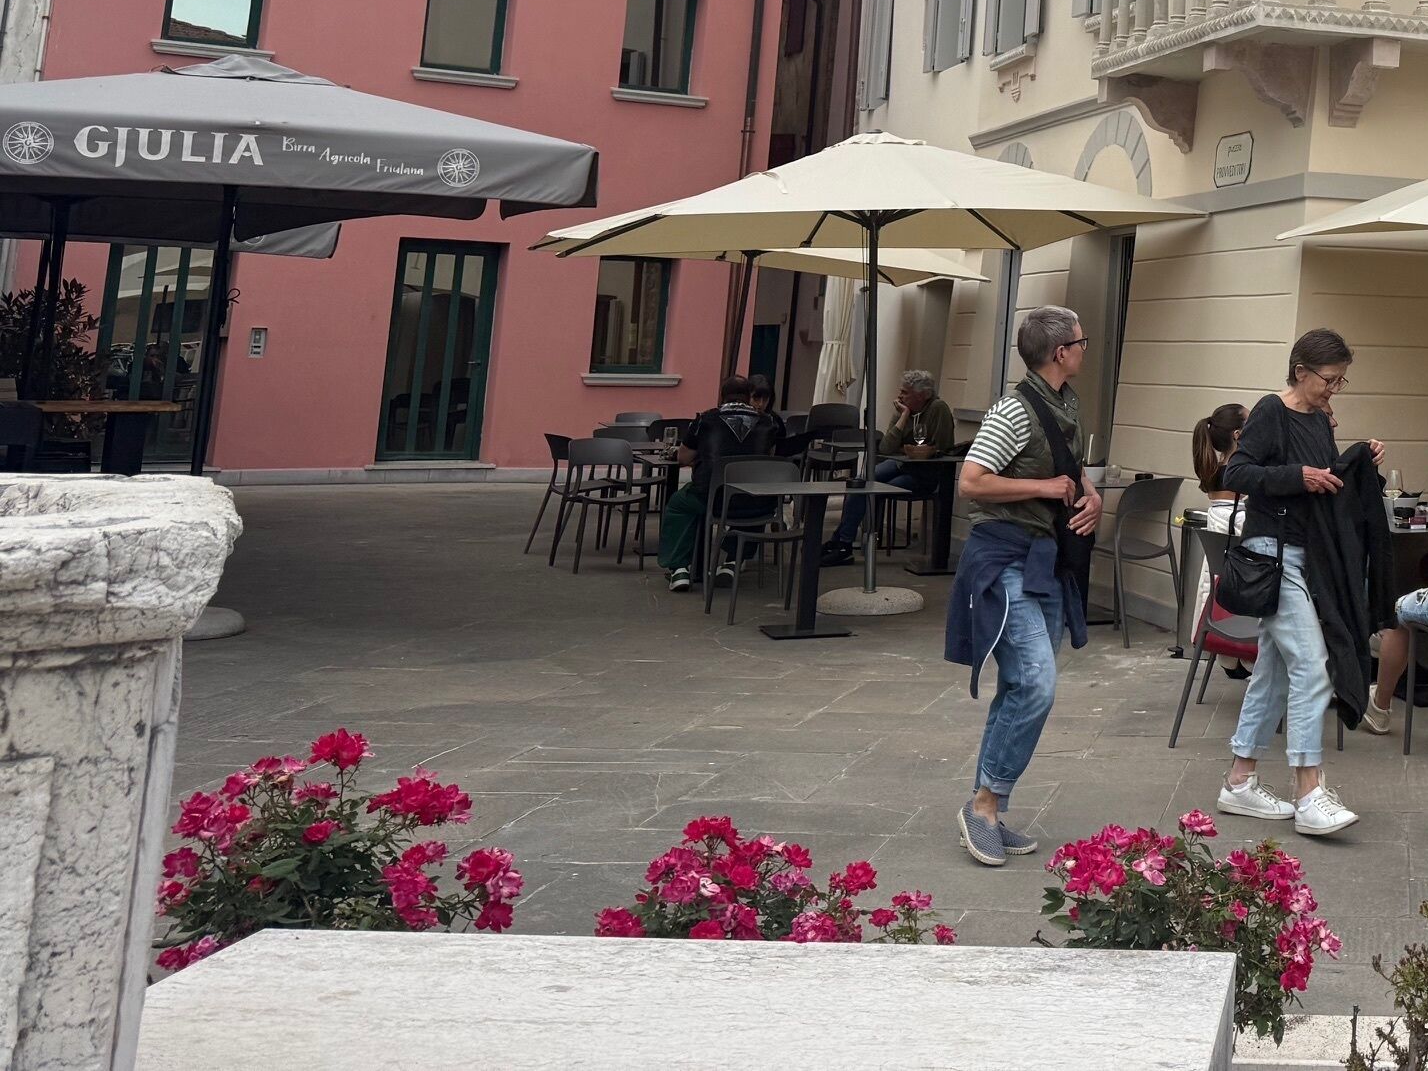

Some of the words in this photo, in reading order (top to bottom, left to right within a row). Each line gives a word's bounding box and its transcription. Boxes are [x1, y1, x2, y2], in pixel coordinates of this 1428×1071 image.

[73, 124, 264, 168] GJULIA
[282, 135, 316, 154] Birra
[319, 147, 371, 165] Agricola
[376, 158, 424, 176] Friulana
